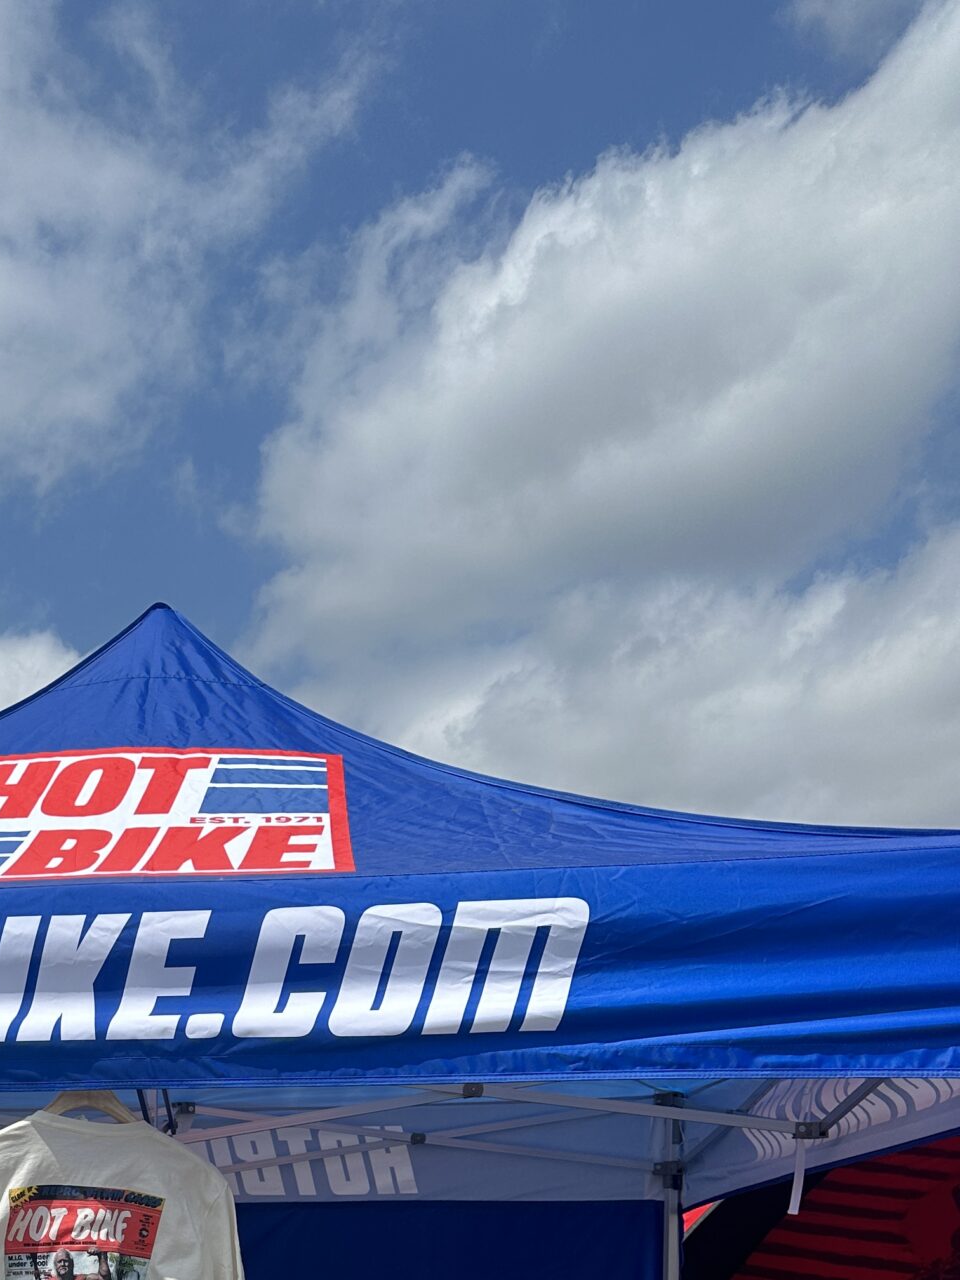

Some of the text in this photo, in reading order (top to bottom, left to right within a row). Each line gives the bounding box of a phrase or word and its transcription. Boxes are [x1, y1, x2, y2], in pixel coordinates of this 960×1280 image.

[189, 815, 323, 825] EST. 1971
[1, 824, 325, 876] BIKE
[7, 1205, 68, 1243] HOT
